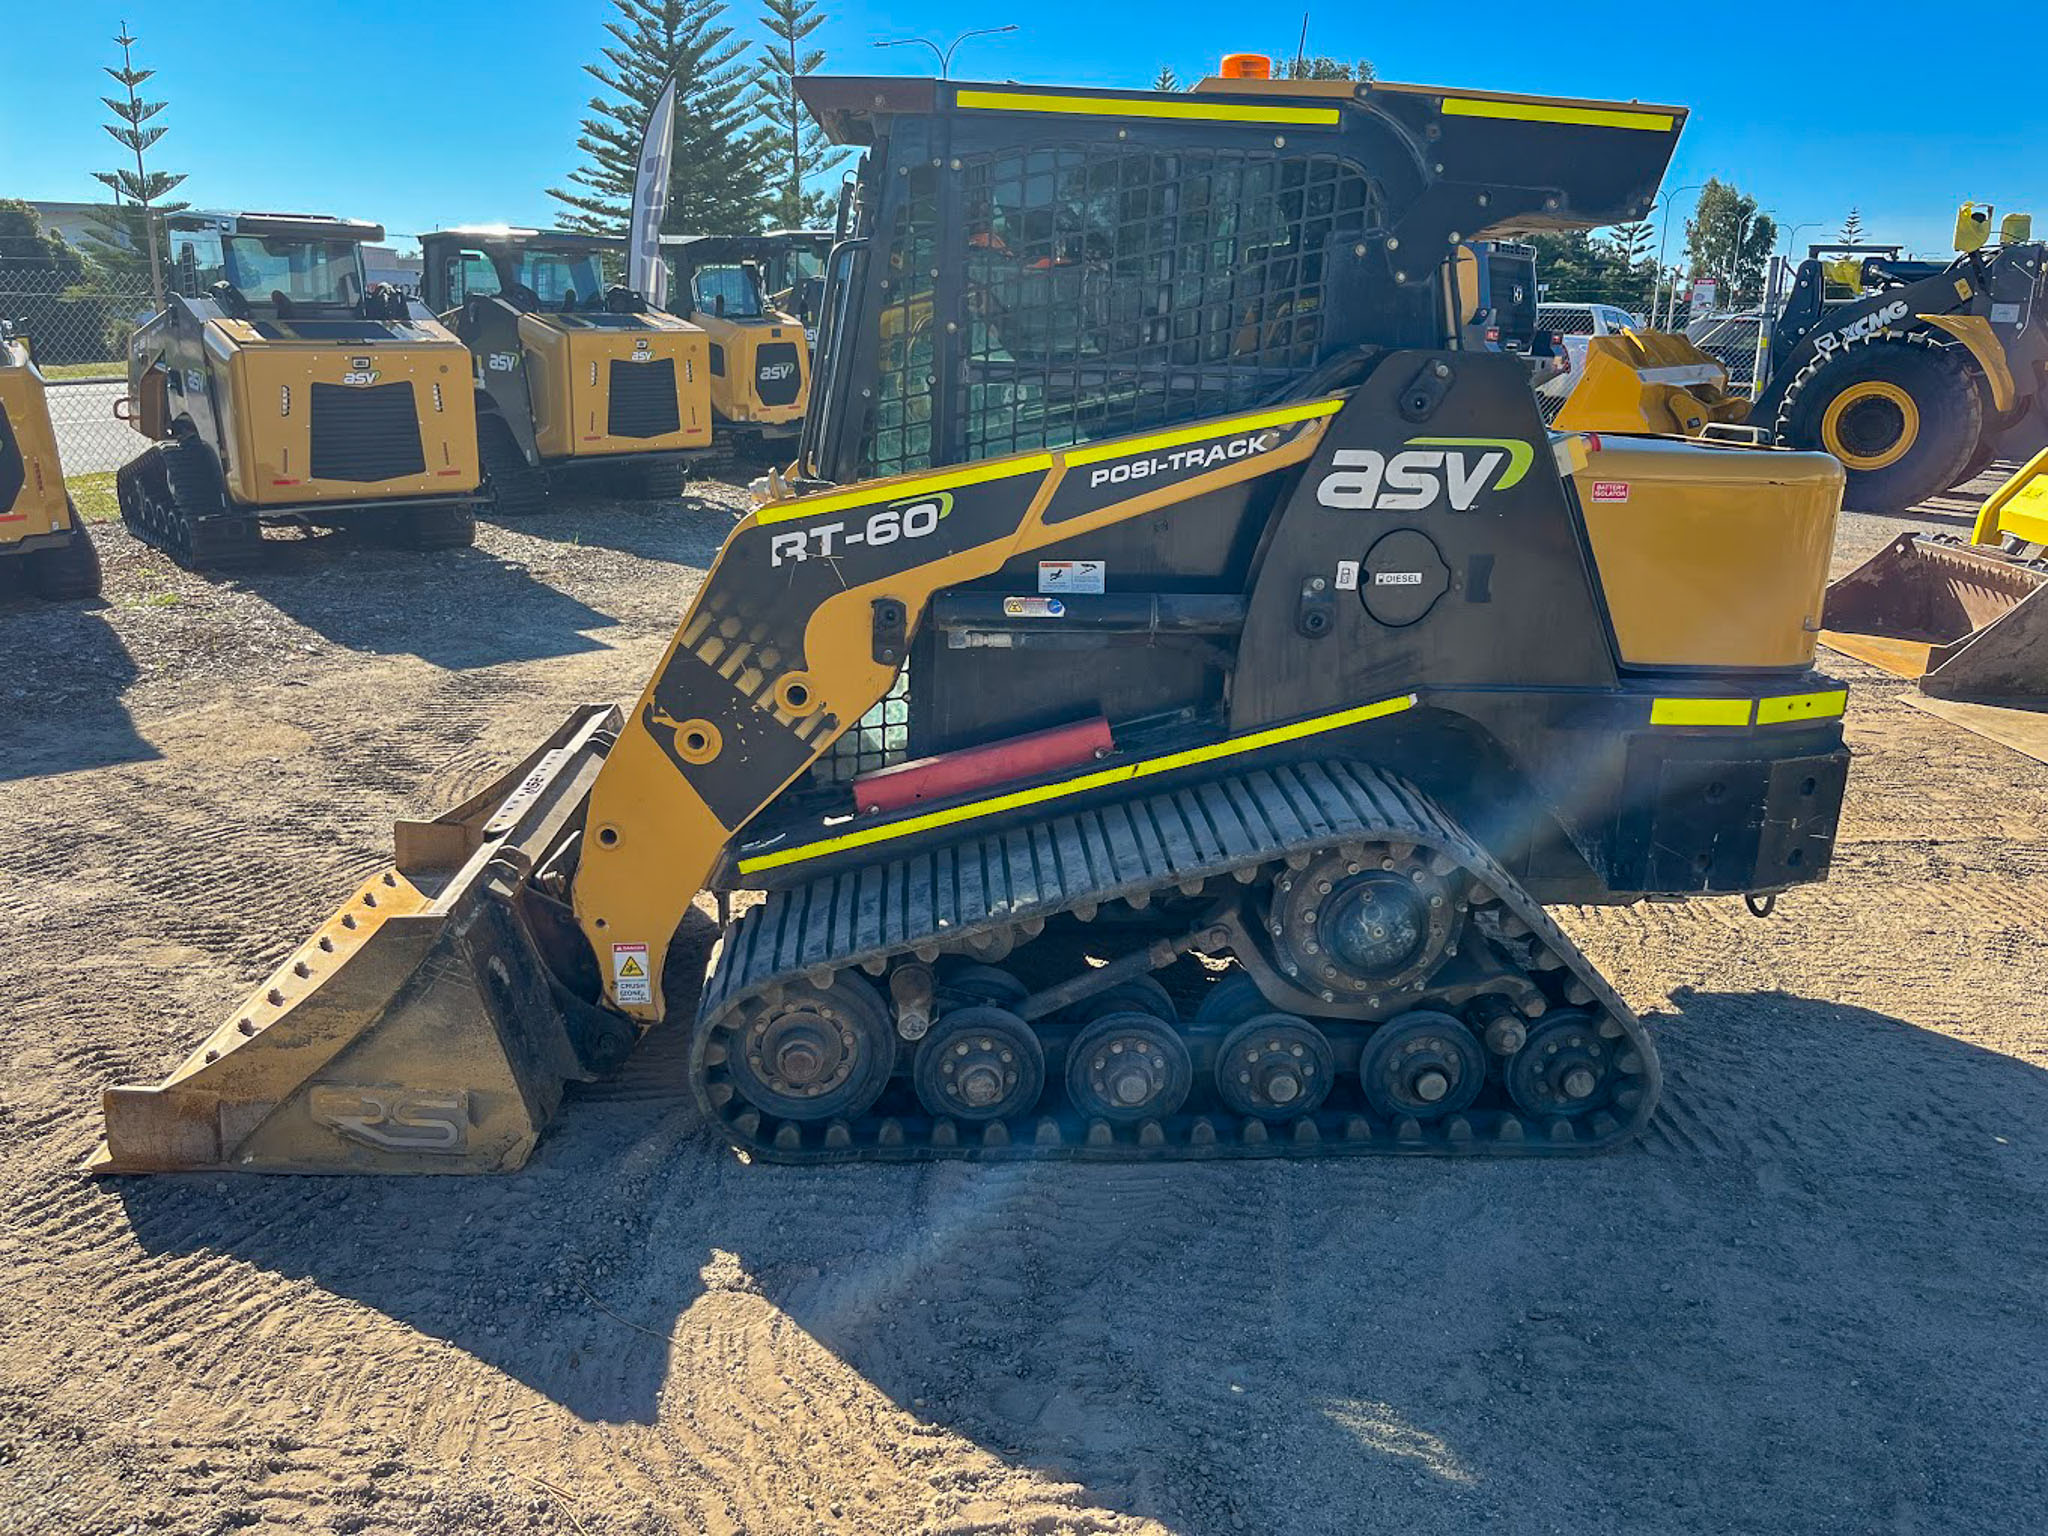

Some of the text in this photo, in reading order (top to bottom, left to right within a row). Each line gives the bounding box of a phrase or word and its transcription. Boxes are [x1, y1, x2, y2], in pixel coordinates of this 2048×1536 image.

[1839, 300, 1909, 338] XCMG
[1090, 434, 1268, 488] POSI-TRACK
[771, 503, 938, 567] RT-60
[1385, 574, 1420, 584] DIESEL
